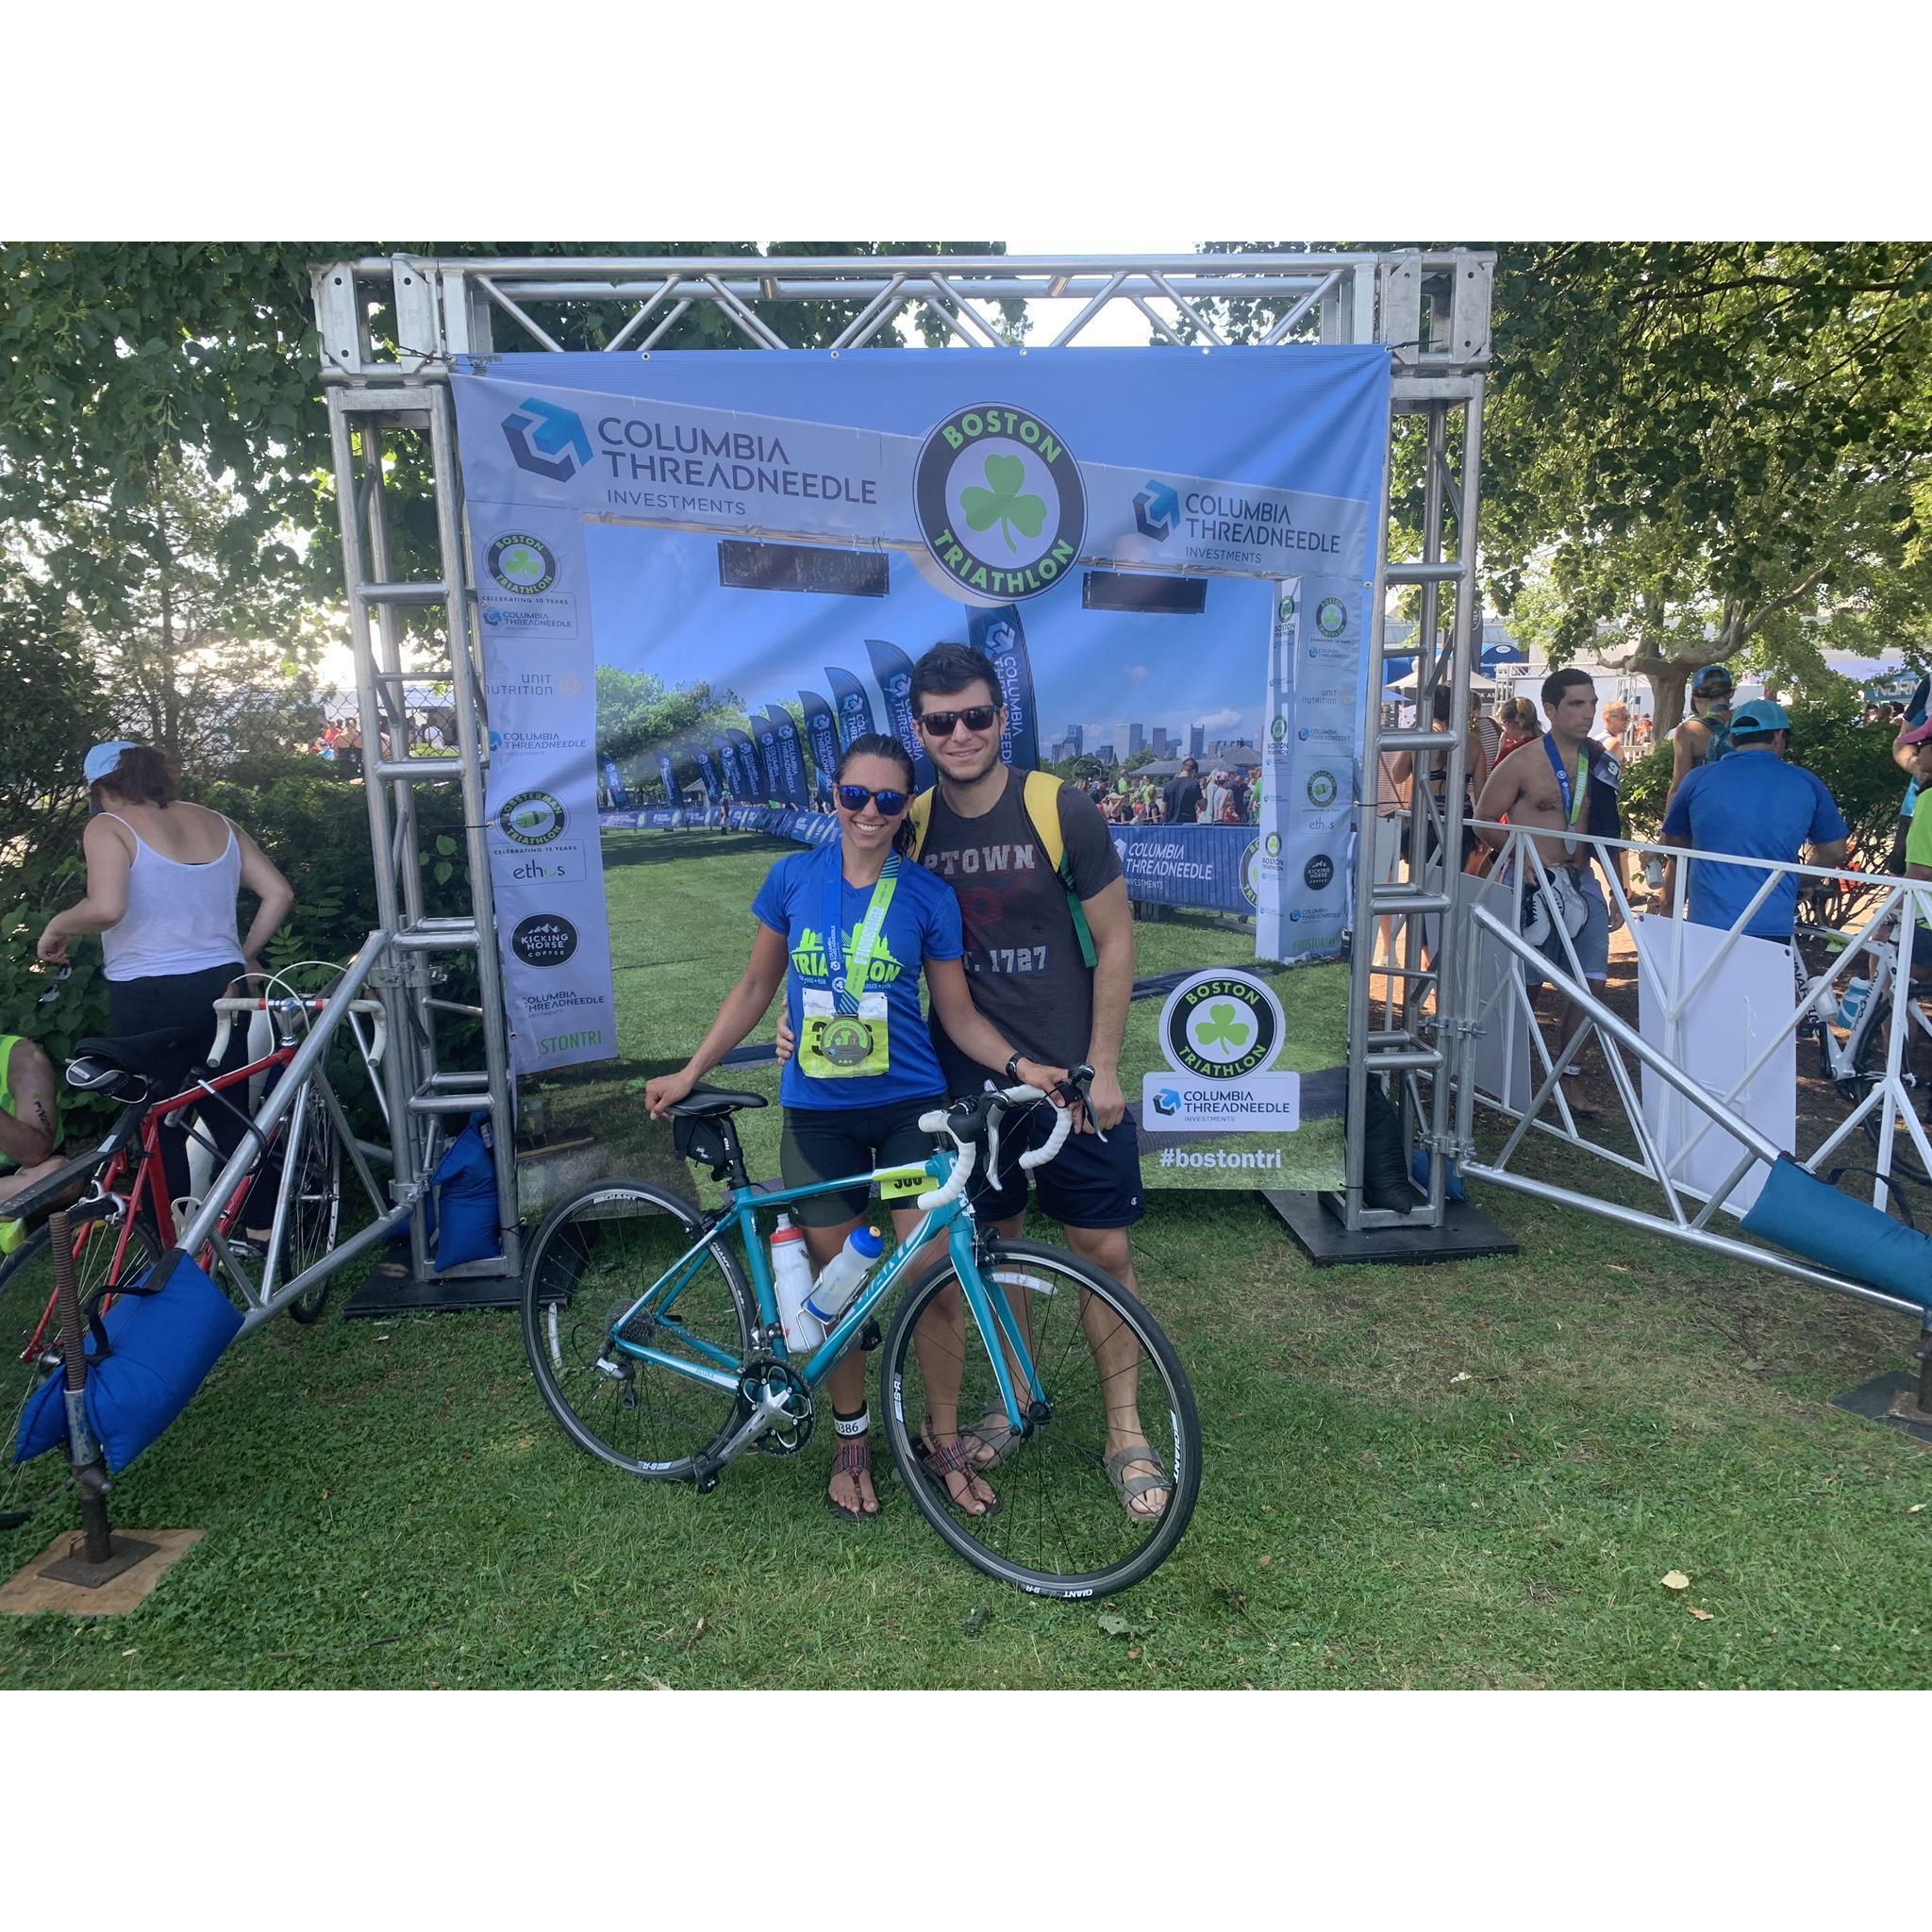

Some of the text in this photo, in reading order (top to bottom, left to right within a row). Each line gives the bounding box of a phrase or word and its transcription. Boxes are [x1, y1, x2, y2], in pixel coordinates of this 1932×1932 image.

[597, 416, 790, 466] COLUMBIA
[941, 409, 1064, 465] BOSTON
[601, 449, 876, 505] THREADNEEDLE
[606, 489, 746, 516] INVESTMENTS
[1185, 492, 1291, 525] COLUMBIA
[495, 535, 544, 553] BOSTON
[1185, 518, 1341, 554] THREADNEEDLE
[931, 528, 1075, 595] TRIATHLON
[1186, 546, 1261, 563] INVESTMENTS
[495, 575, 554, 594] TRIATHLON
[502, 610, 549, 620] COLUMBIA
[504, 619, 572, 627] THREADNEEDLE
[1004, 657, 1024, 737] COLUMBIA
[504, 732, 559, 741] COLUMBIA
[504, 740, 586, 749] THREADNEEDLE
[824, 731, 835, 774] COLUMBIA
[503, 792, 562, 818] LOBSTERMAN
[507, 824, 562, 845] TRIATHLON
[1128, 842, 1184, 859] COLUMBIA
[1126, 858, 1213, 880] THREADNEEDLE
[521, 934, 568, 943] KICKING
[526, 941, 564, 950] HORSE
[990, 945, 1046, 974] 1727
[525, 996, 605, 1012] HREADNEEDLE
[1185, 982, 1259, 1006] BOSTON
[1179, 1044, 1267, 1076] TRIATHLON
[1184, 1091, 1254, 1101] COLUMBIA
[1185, 1103, 1290, 1113] THREADNEEDLE
[1159, 1148, 1281, 1169] #bostontri
[712, 1241, 731, 1269] GIANT
[1063, 1589, 1093, 1598] GIANT
